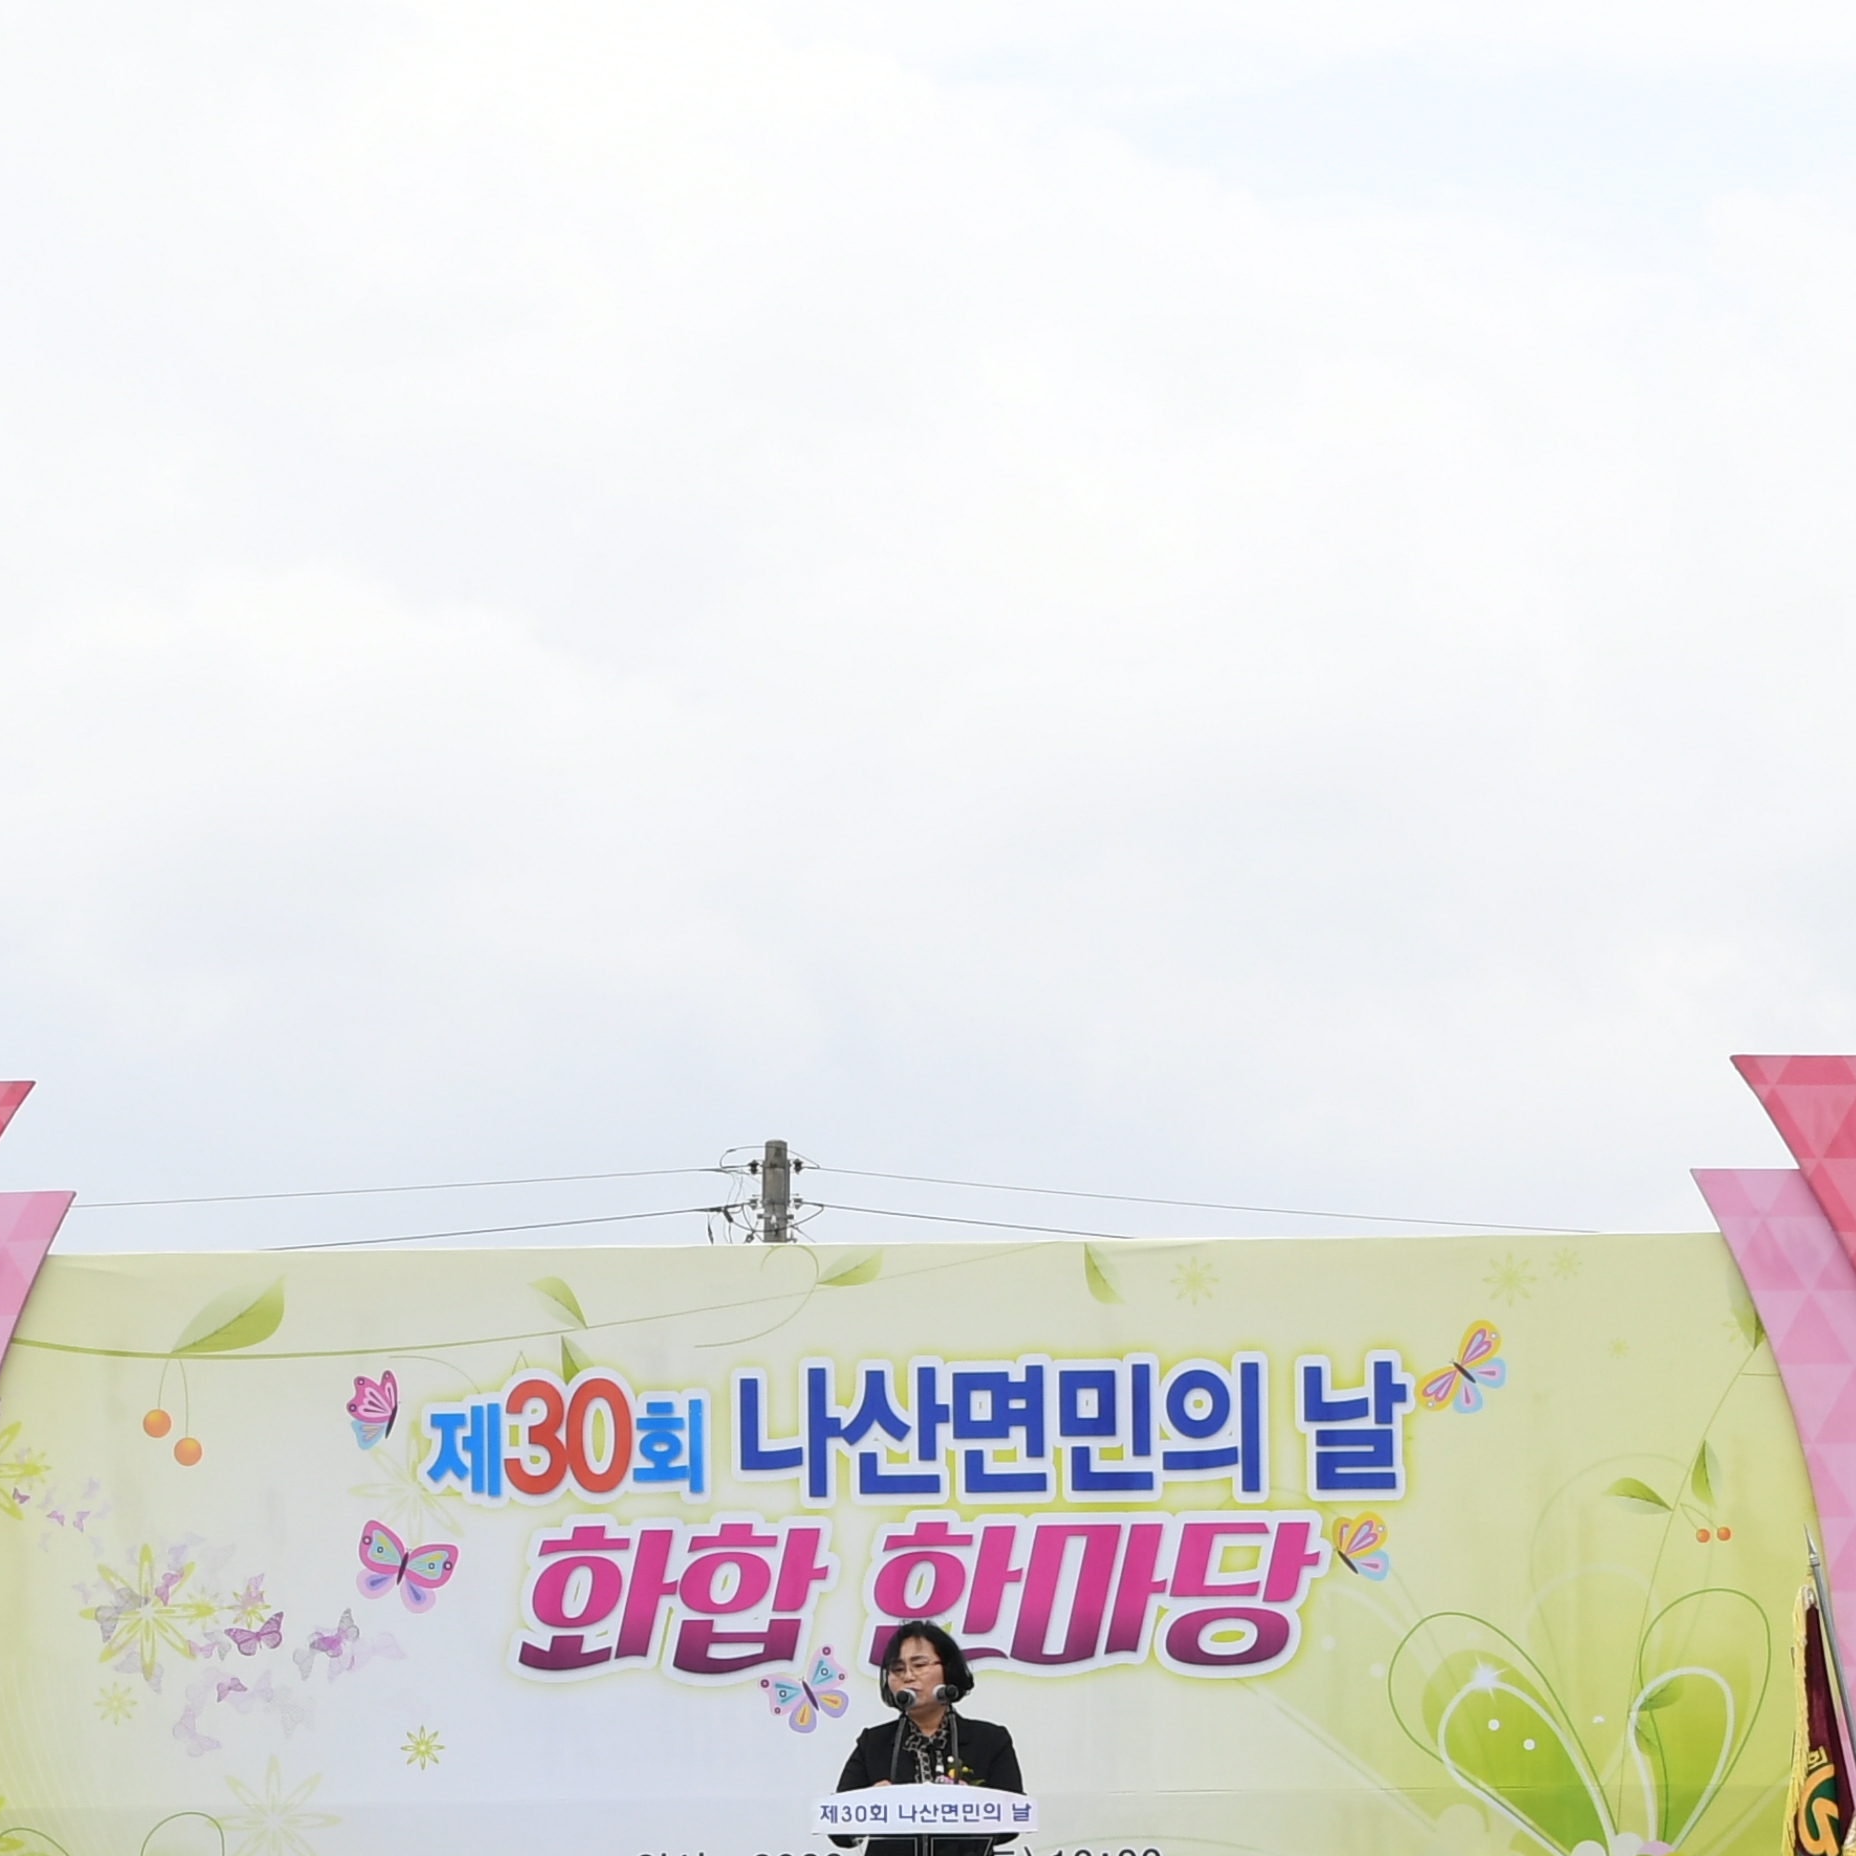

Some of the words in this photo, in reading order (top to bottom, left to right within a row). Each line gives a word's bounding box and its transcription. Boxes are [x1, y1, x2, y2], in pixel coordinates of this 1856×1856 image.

[427, 1378, 703, 1497] 제30회
[740, 1362, 1260, 1498] 나산면민의
[1303, 1360, 1407, 1490] 날
[519, 1523, 829, 1674] 화합
[869, 1521, 1320, 1666] 한마당
[820, 1804, 888, 1824] 제30회
[898, 1802, 1001, 1823] 나산면민의
[1012, 1803, 1032, 1822] 날
